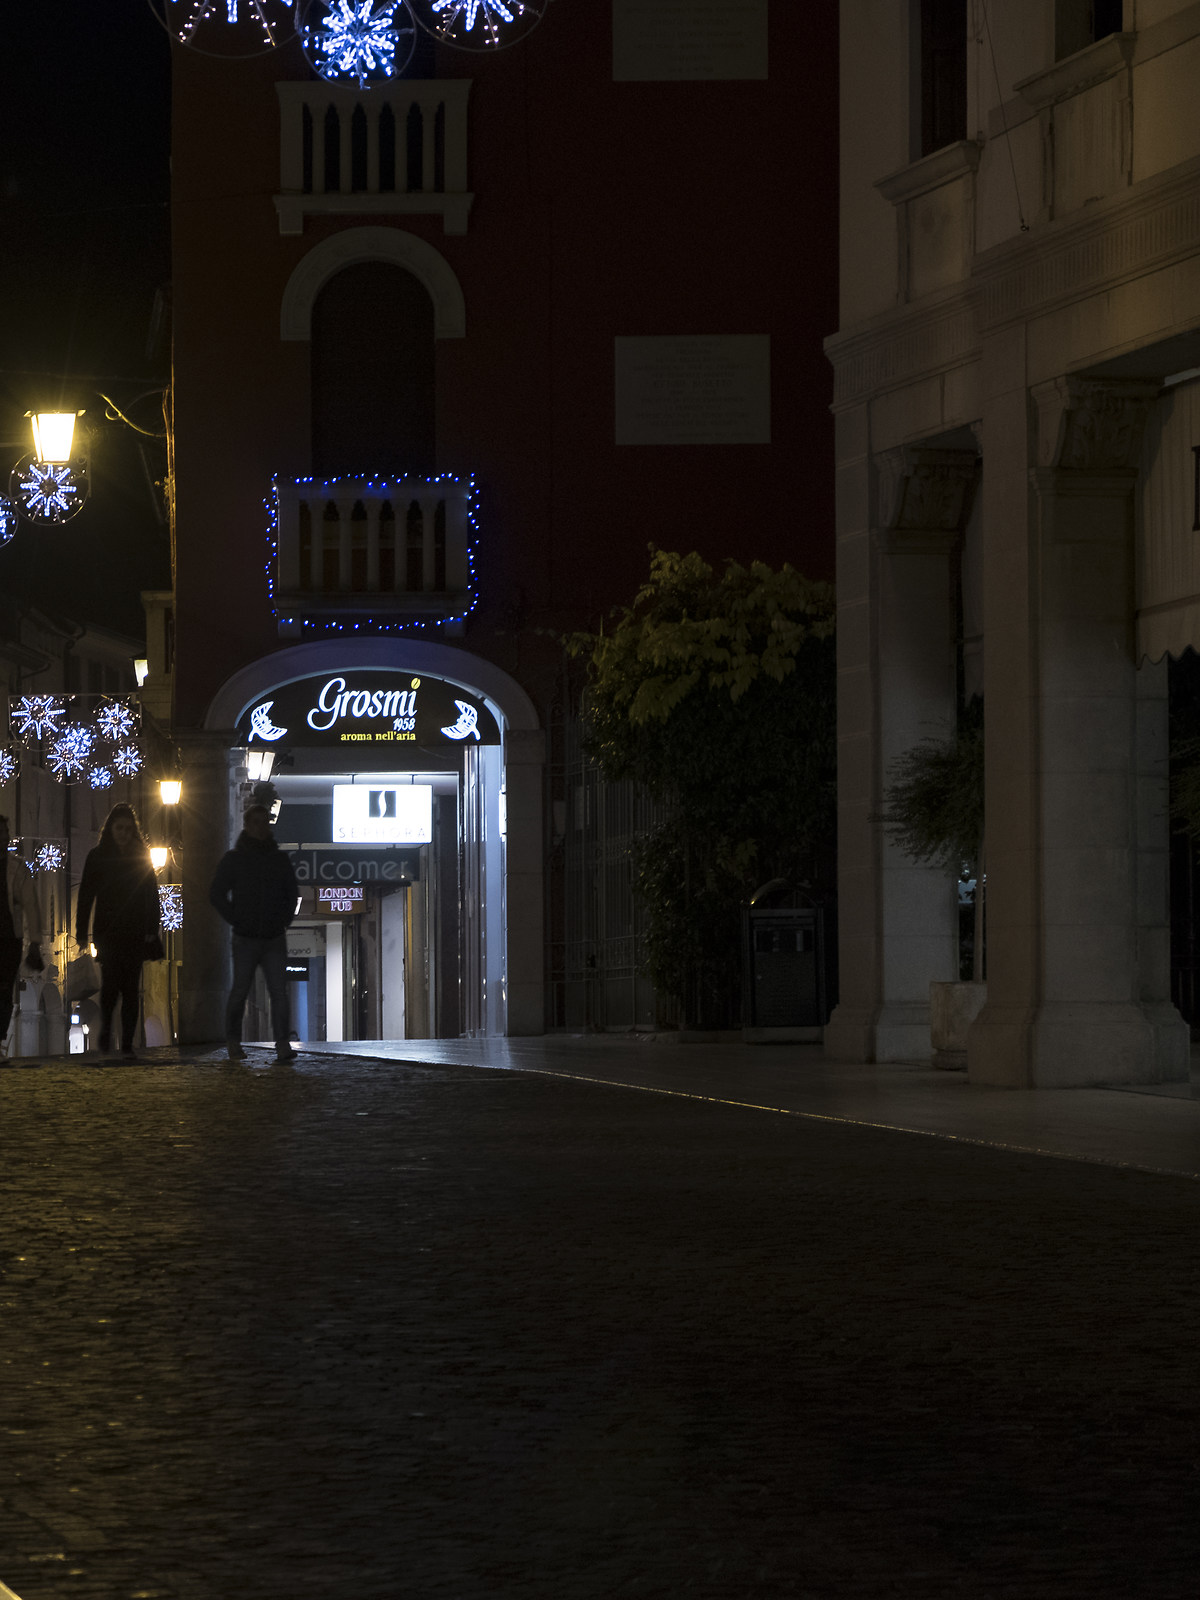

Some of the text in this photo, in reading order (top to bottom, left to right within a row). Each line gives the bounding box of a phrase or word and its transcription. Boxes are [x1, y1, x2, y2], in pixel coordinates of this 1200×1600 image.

[306, 677, 421, 731] Grosmi
[392, 717, 416, 731] 1958
[340, 731, 416, 741] aroma nell'aria
[339, 827, 425, 839] SEPHORA
[319, 888, 364, 899] LONDON
[330, 901, 353, 912] PUB
